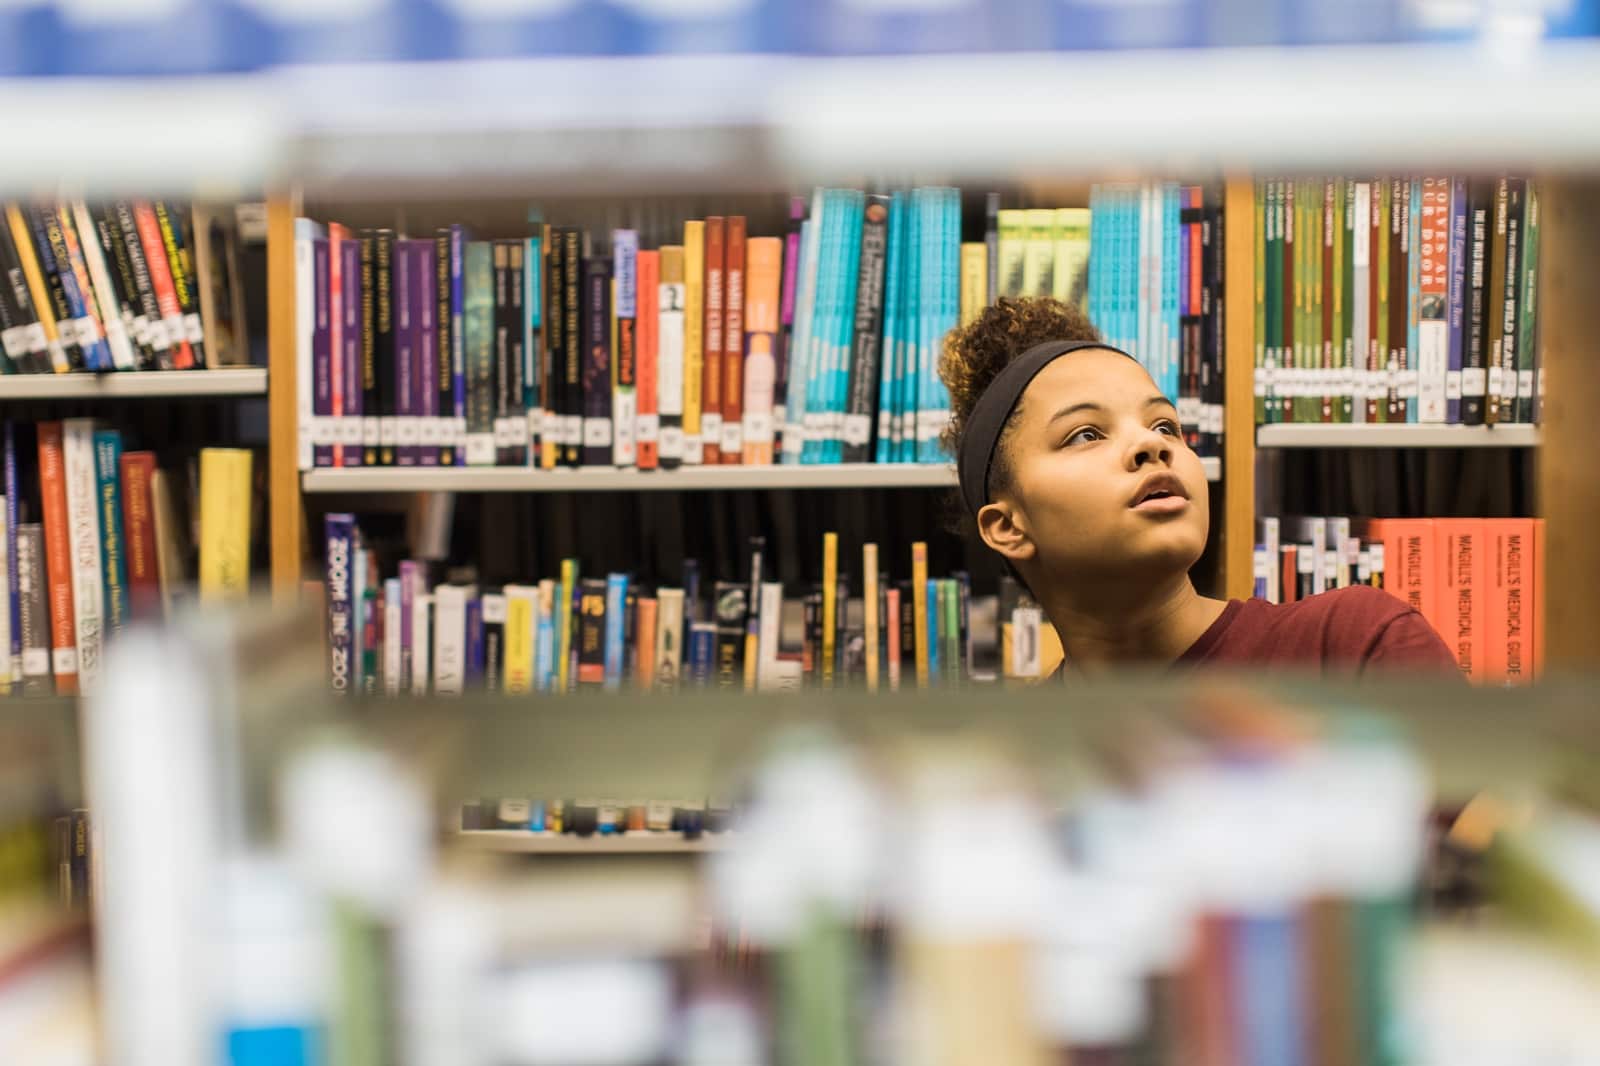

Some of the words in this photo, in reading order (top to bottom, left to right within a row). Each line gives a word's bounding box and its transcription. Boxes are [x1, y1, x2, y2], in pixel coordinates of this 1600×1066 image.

[1421, 177, 1435, 217] OUR
[1435, 177, 1448, 254] WOLVES
[1474, 209, 1486, 223] THE
[1473, 241, 1484, 259] WILD
[1474, 223, 1485, 241] LAST
[1421, 228, 1434, 286] DOOR
[1435, 263, 1447, 286] AT
[1472, 259, 1484, 289] WOLVES
[1503, 299, 1515, 333] WILD
[1407, 535, 1422, 587] MAGILL'S
[1458, 535, 1473, 586] MAGILL'S
[1507, 534, 1521, 586] MAGILL'S
[1458, 588, 1472, 639] MEDICAL
[1506, 588, 1521, 639] MEDICAL
[1506, 641, 1521, 676] GUIDE
